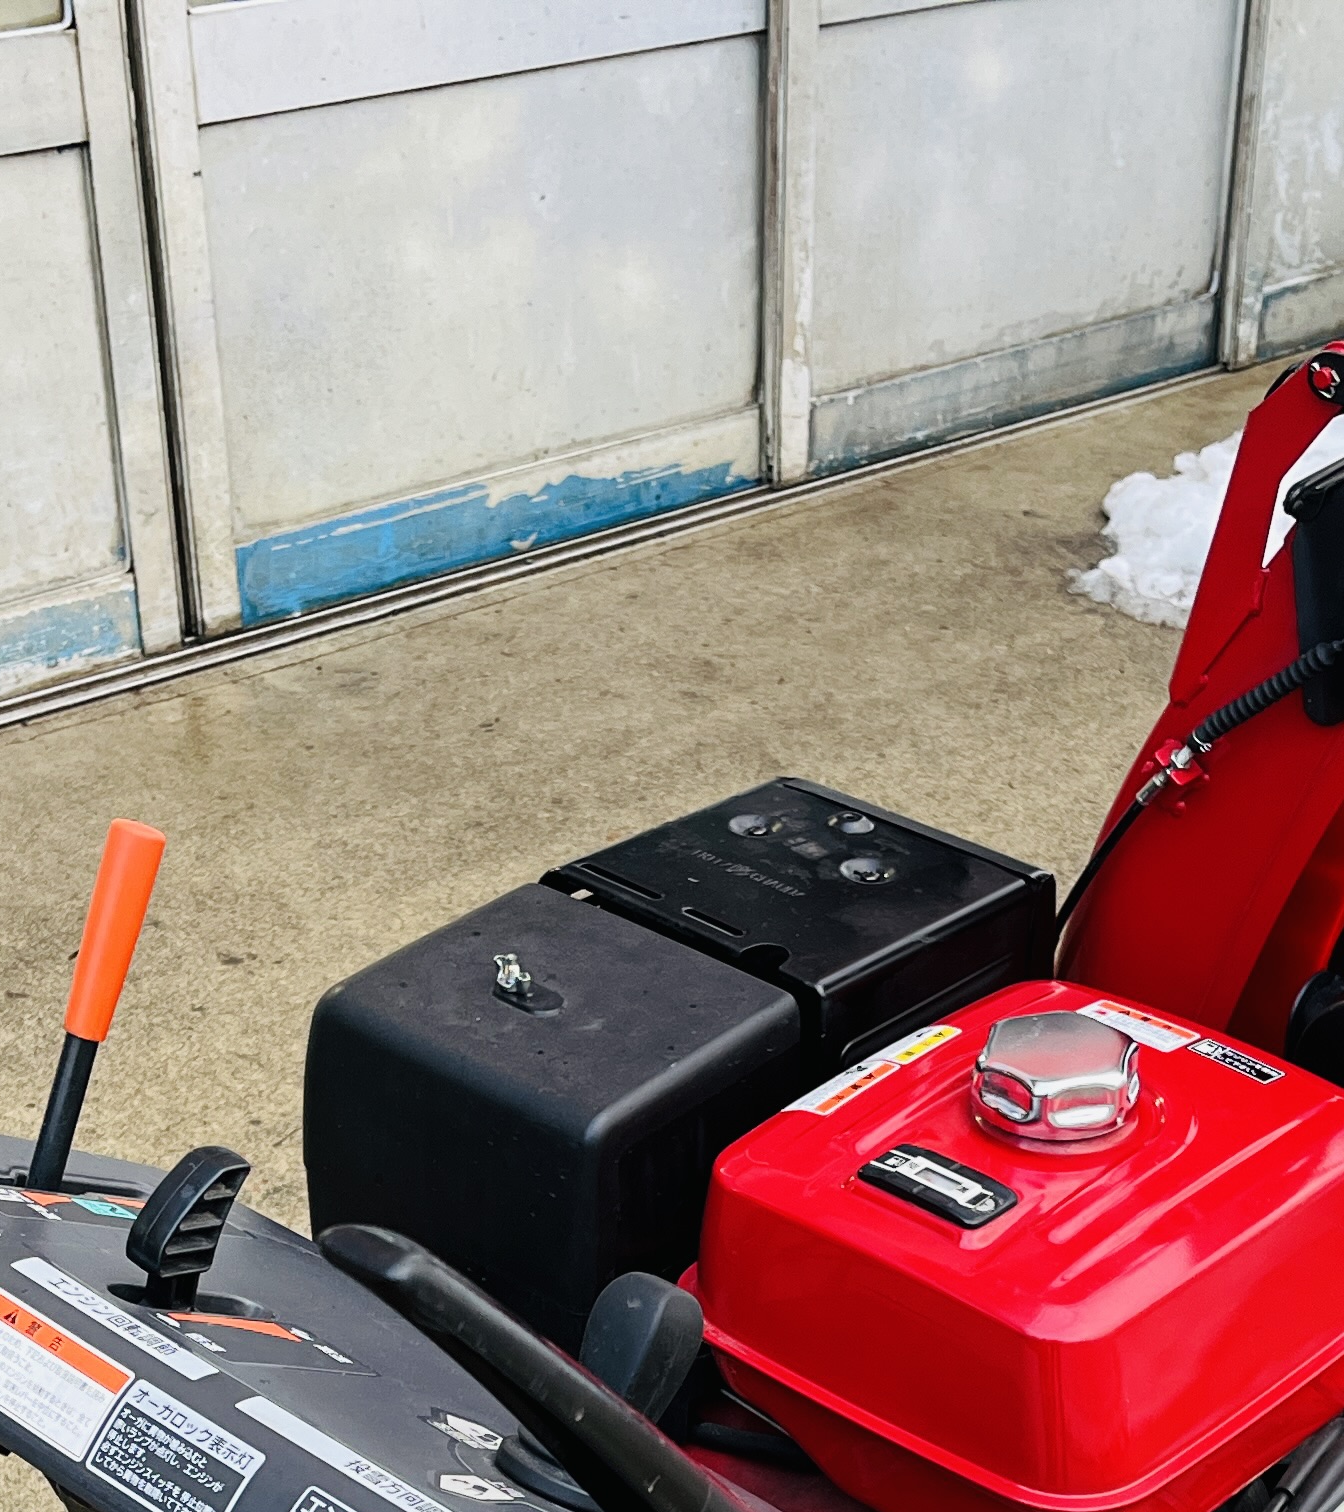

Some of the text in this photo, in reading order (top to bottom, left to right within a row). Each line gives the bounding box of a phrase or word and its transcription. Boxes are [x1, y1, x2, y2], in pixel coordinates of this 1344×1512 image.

[48, 1277, 180, 1356] エンジン回転調節
[132, 1388, 255, 1471] オーガロック表示灯
